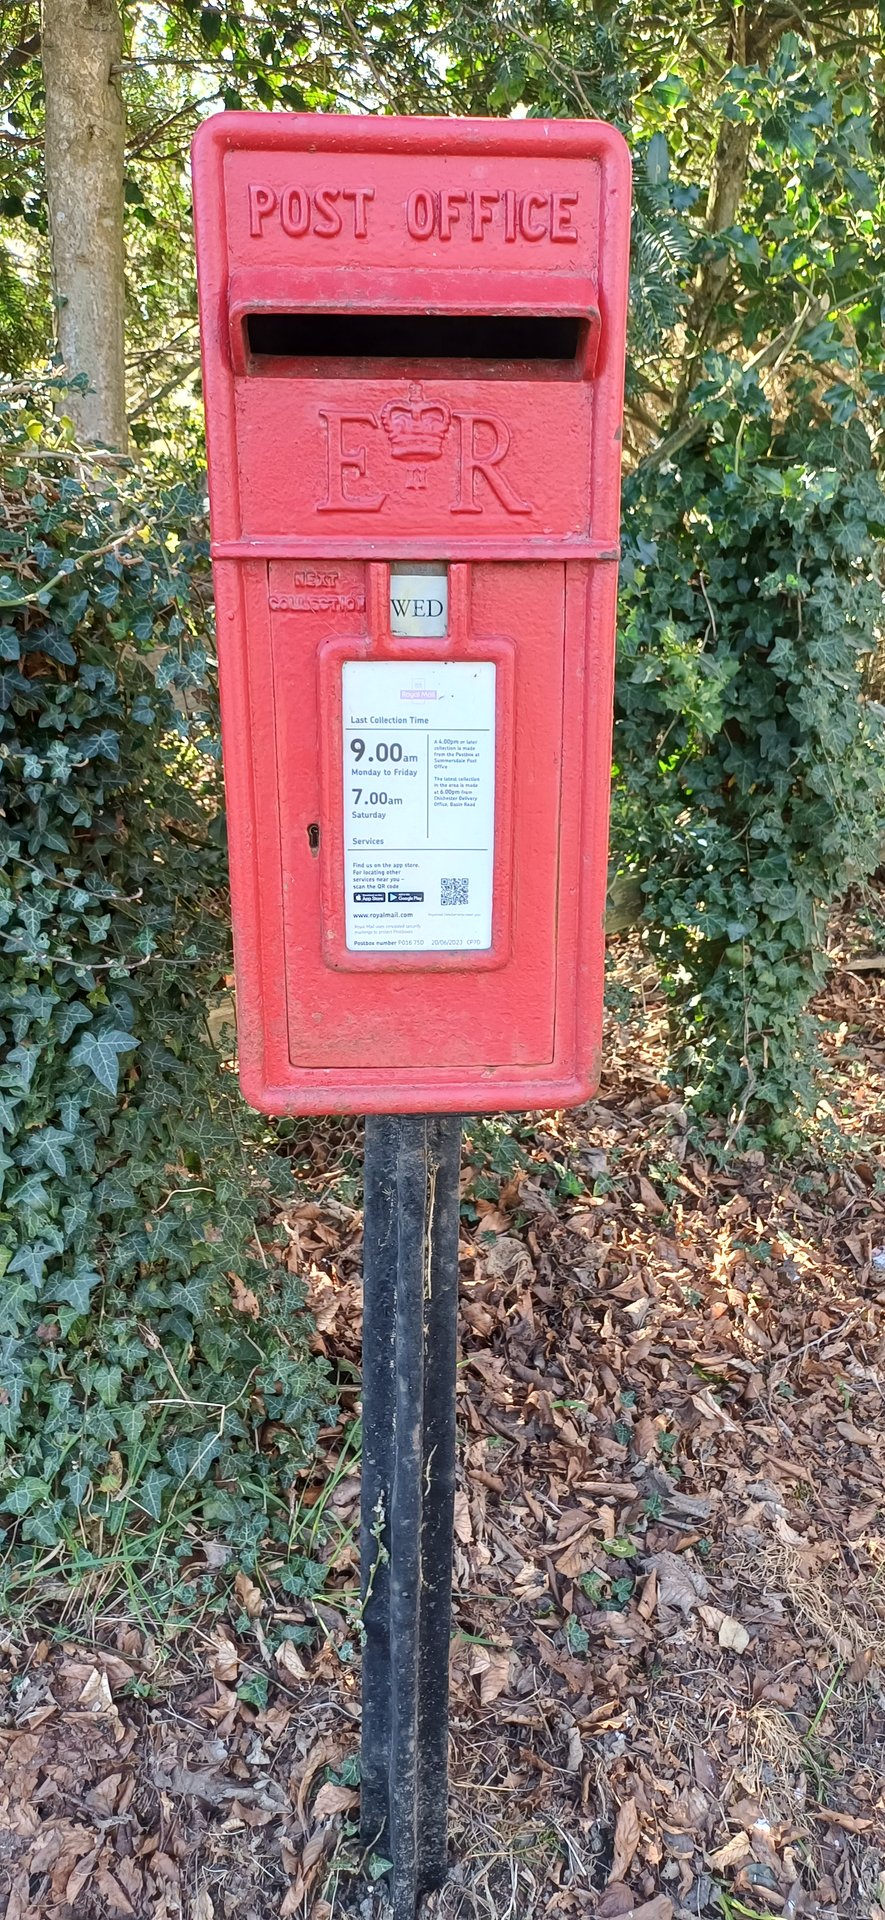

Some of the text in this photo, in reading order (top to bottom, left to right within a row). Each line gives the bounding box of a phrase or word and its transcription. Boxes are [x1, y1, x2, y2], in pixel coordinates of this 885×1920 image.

[247, 183, 579, 244] POST OFFICE
[316, 409, 389, 513] E
[449, 409, 532, 514] R
[294, 571, 339, 588] NEXT
[269, 594, 367, 613] COLLECTION
[390, 599, 444, 618] WED
[401, 691, 420, 699] Royal
[350, 716, 429, 724] Last Collection Time
[350, 738, 418, 762] 9.00am
[351, 769, 381, 777] Monday
[394, 769, 418, 777] Friday
[351, 788, 403, 805] 7.00am
[352, 811, 386, 820] Saturday
